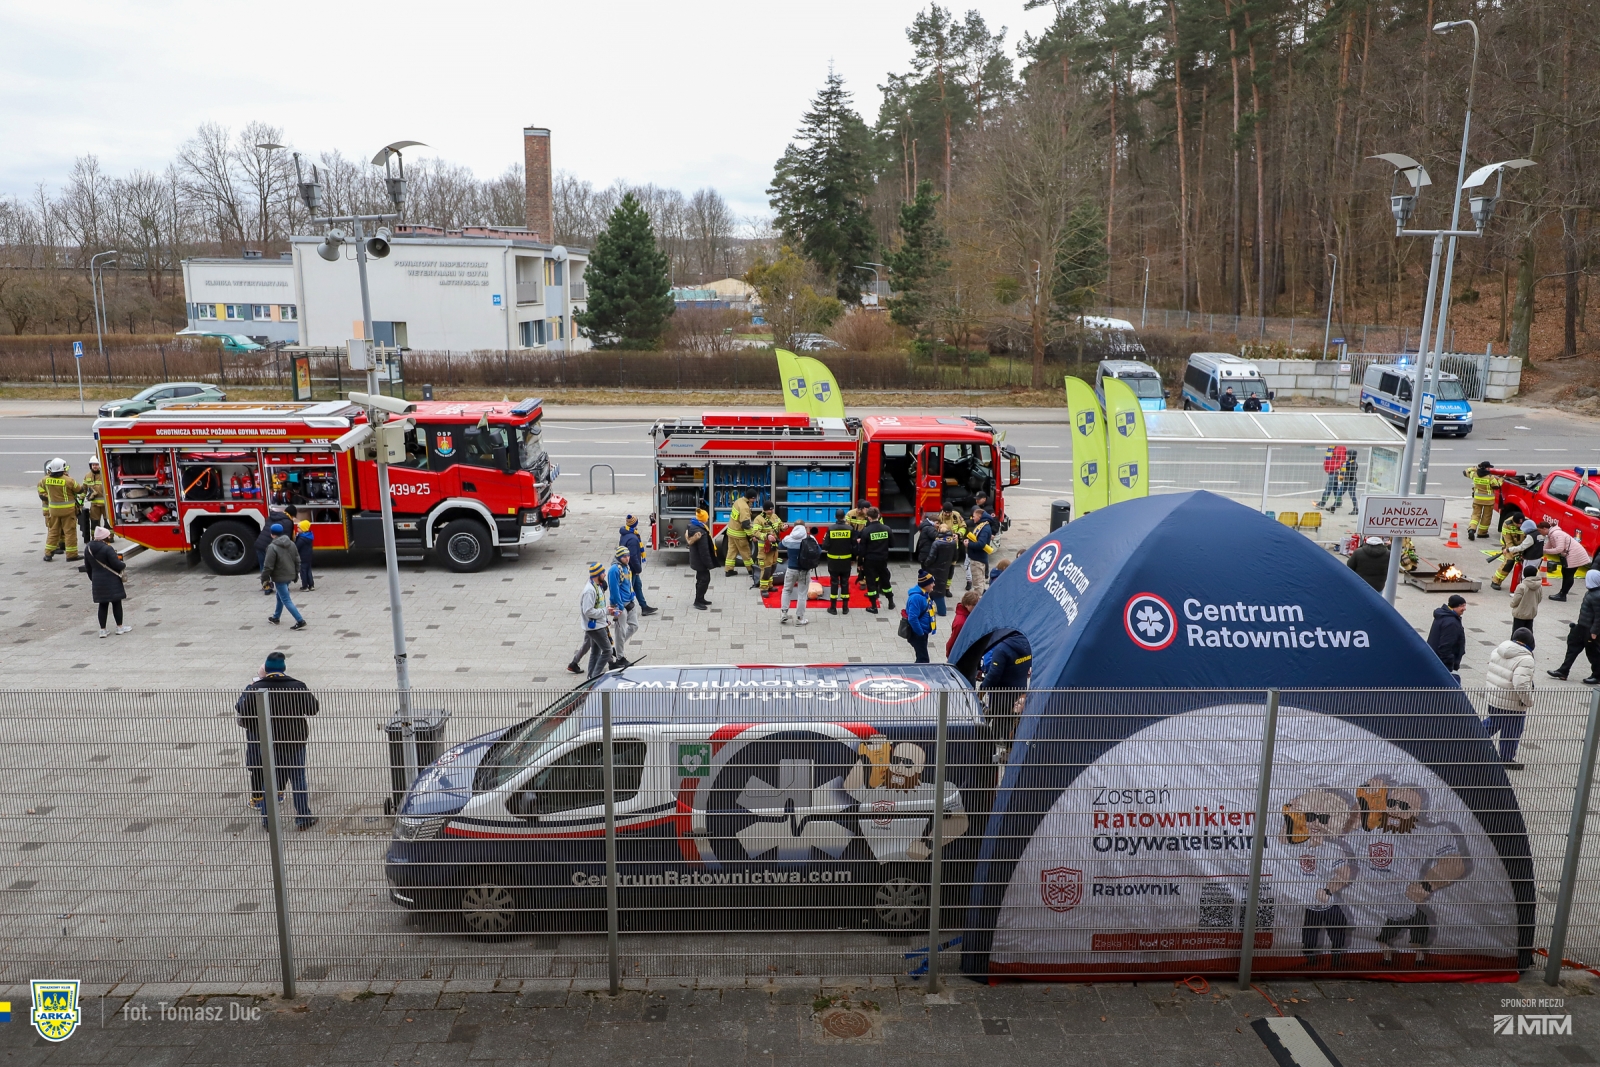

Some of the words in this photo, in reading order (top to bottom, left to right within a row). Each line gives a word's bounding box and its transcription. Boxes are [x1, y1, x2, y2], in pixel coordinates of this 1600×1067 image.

[192, 428, 210, 436] STRAŻ
[211, 428, 237, 436] POŻARNA
[1382, 507, 1428, 516] JANUSZA
[1368, 517, 1438, 527] KUPCEWICZA
[1058, 553, 1090, 595] Centrum
[1183, 598, 1304, 622] Centrum
[1186, 625, 1370, 648] Ratownictwa
[617, 679, 839, 690] Ratownictwa
[1092, 784, 1171, 806] Zostań
[1093, 880, 1181, 897] Ratownik
[1139, 938, 1158, 947] kod
[1160, 939, 1175, 948] QR
[1182, 937, 1226, 946] POBIERZ
